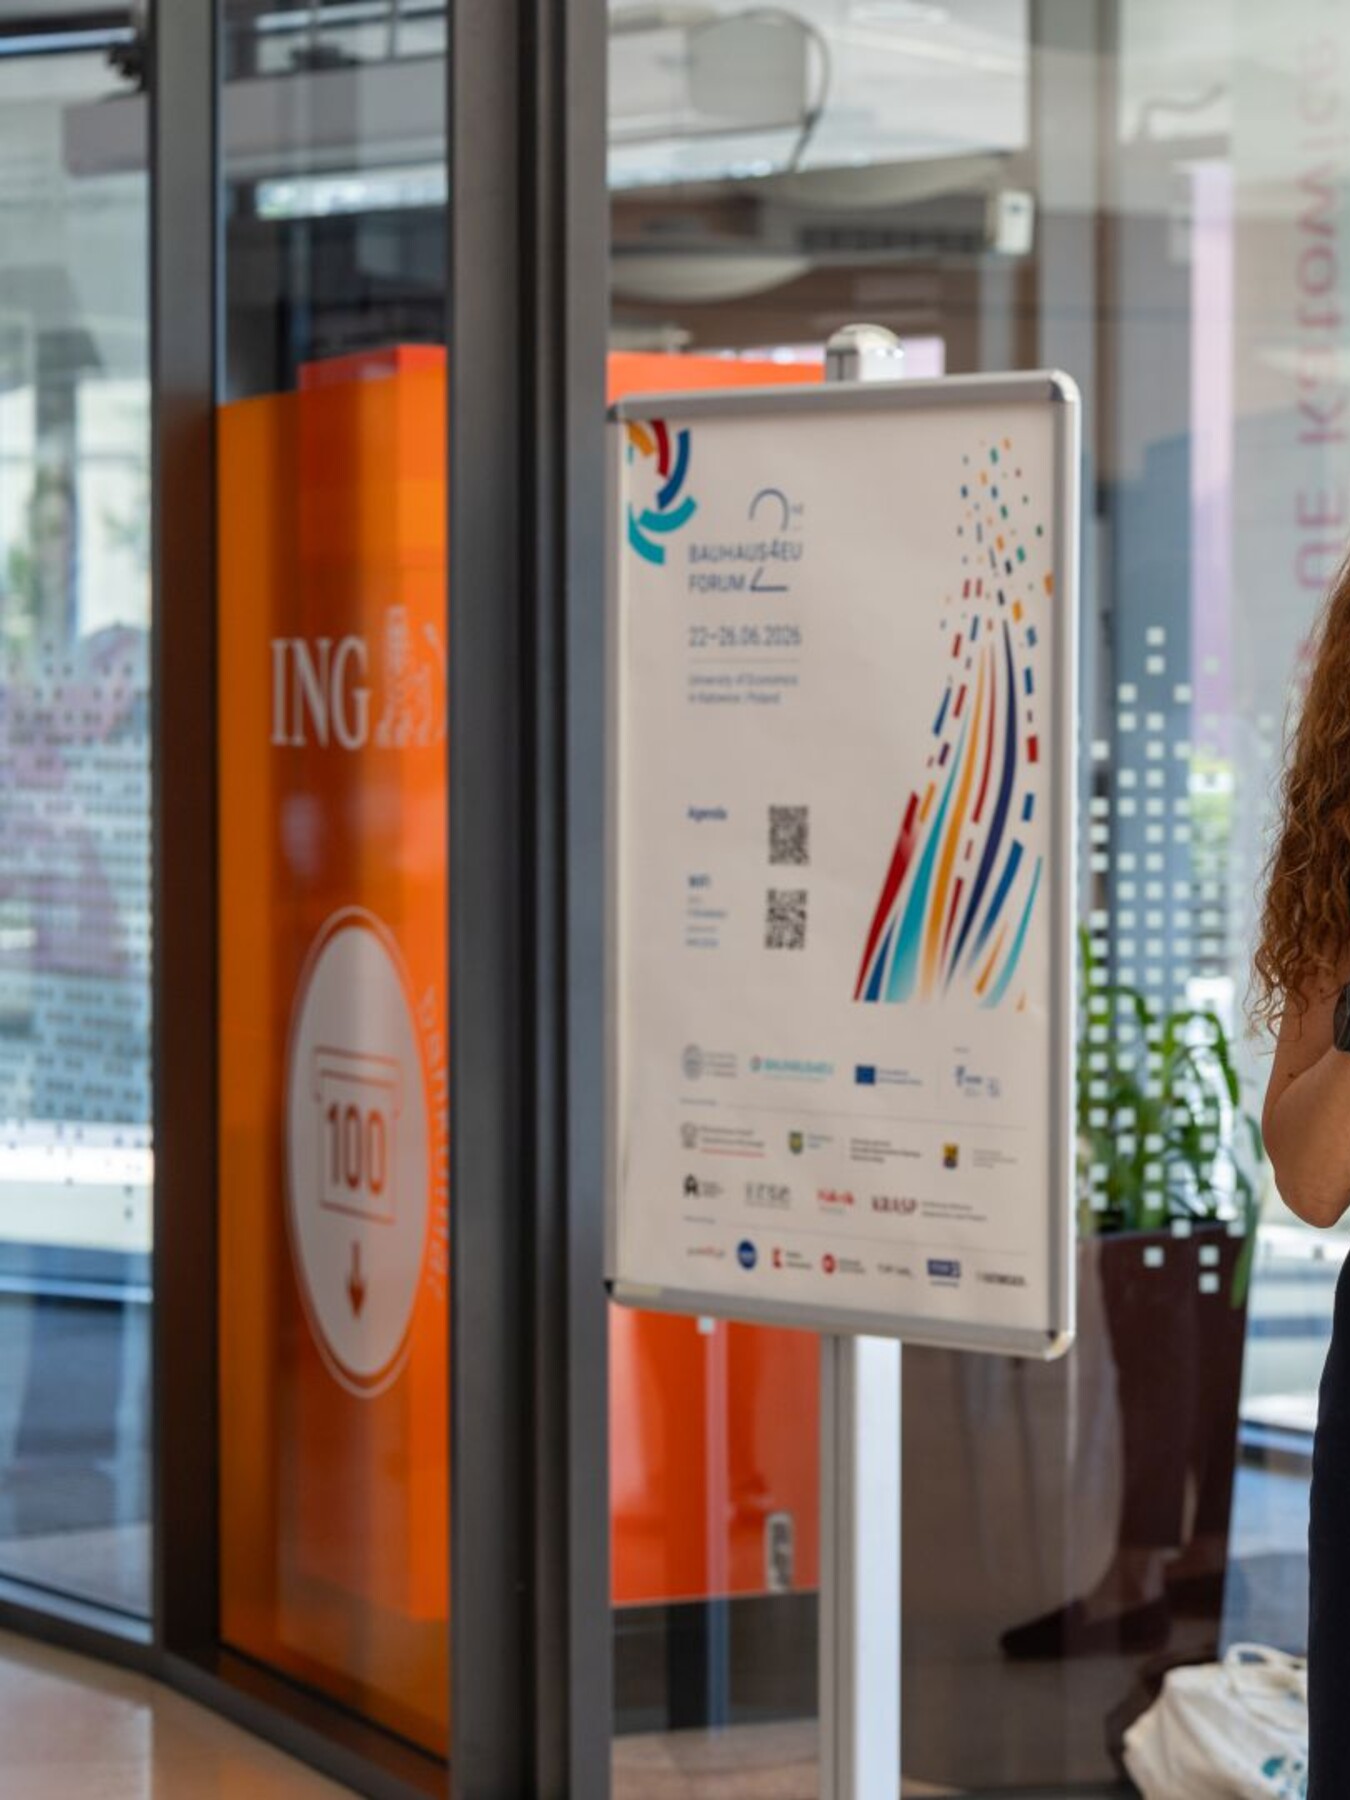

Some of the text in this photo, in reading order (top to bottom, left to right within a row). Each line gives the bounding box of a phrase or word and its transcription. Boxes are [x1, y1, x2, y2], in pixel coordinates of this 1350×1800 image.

[688, 539, 803, 562] BAUHAUS4EU
[688, 573, 745, 593] FORUM
[270, 634, 373, 752] ING
[327, 1103, 387, 1196] 100
